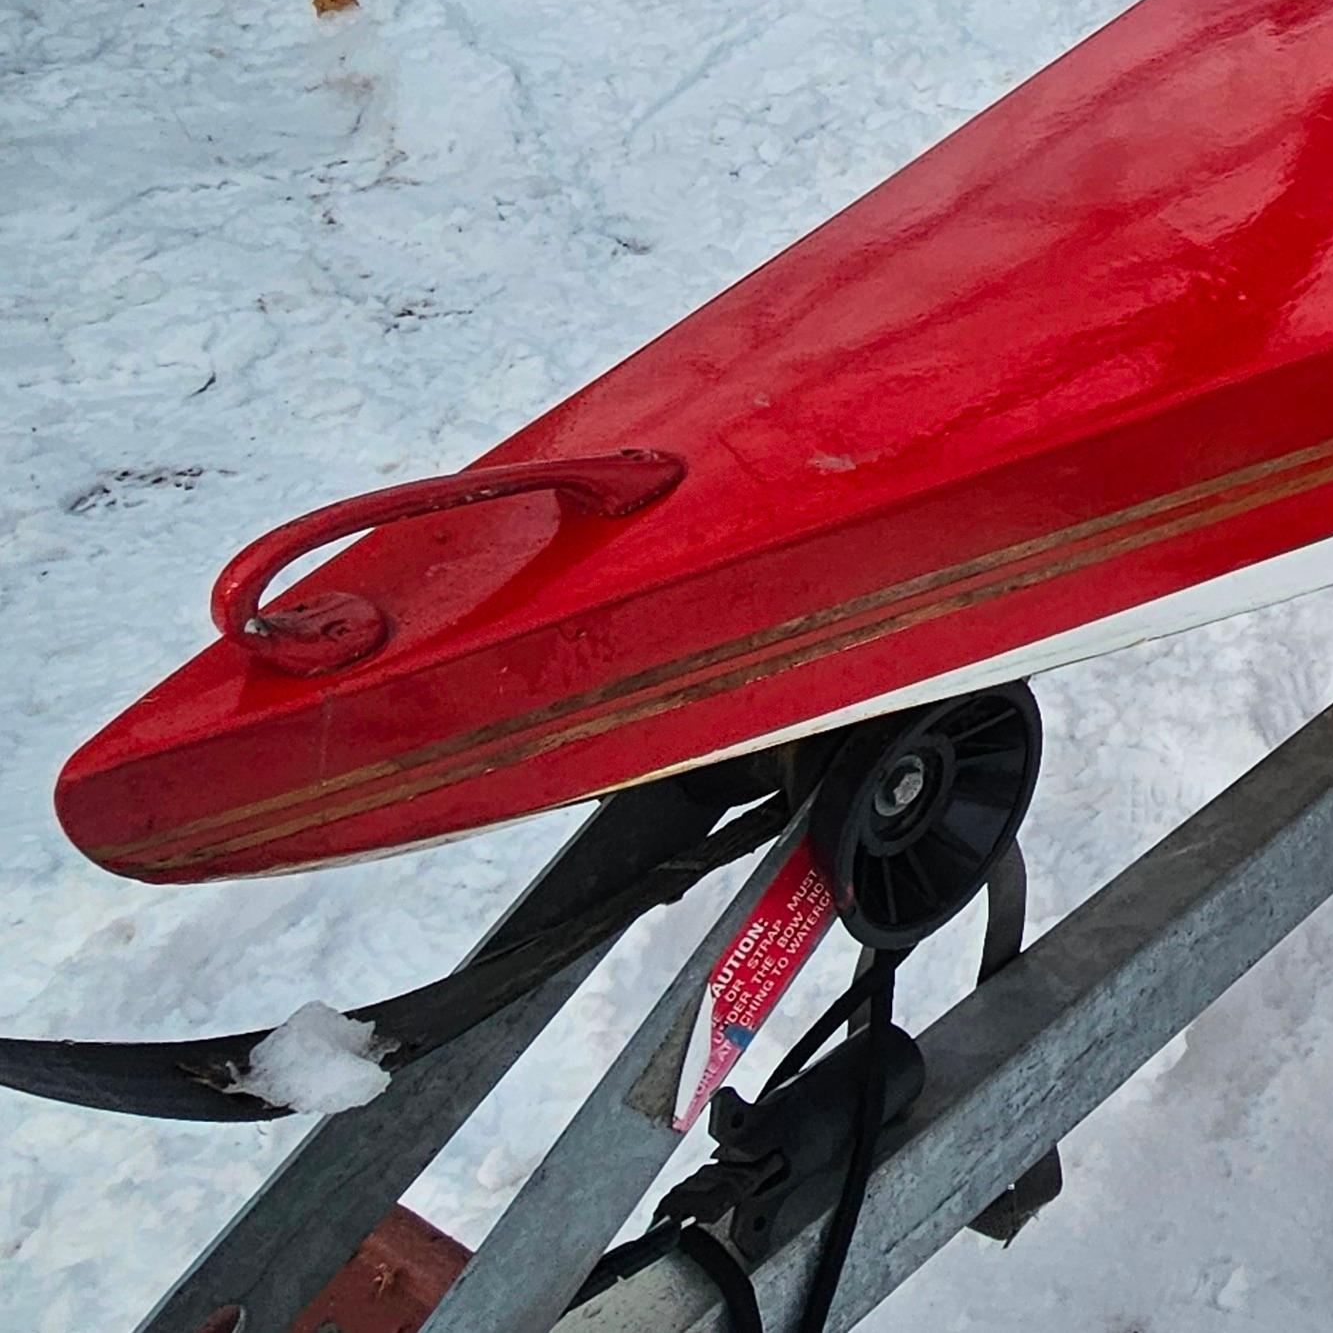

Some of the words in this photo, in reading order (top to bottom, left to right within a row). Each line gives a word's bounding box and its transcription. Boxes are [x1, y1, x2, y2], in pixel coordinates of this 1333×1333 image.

[714, 992, 752, 1044] UDER
[751, 955, 776, 984] THE
[777, 912, 804, 948] BOW
[725, 978, 745, 1003] OR
[747, 919, 783, 970] STRAP
[787, 869, 818, 912] MUST
[772, 955, 789, 977] TO
